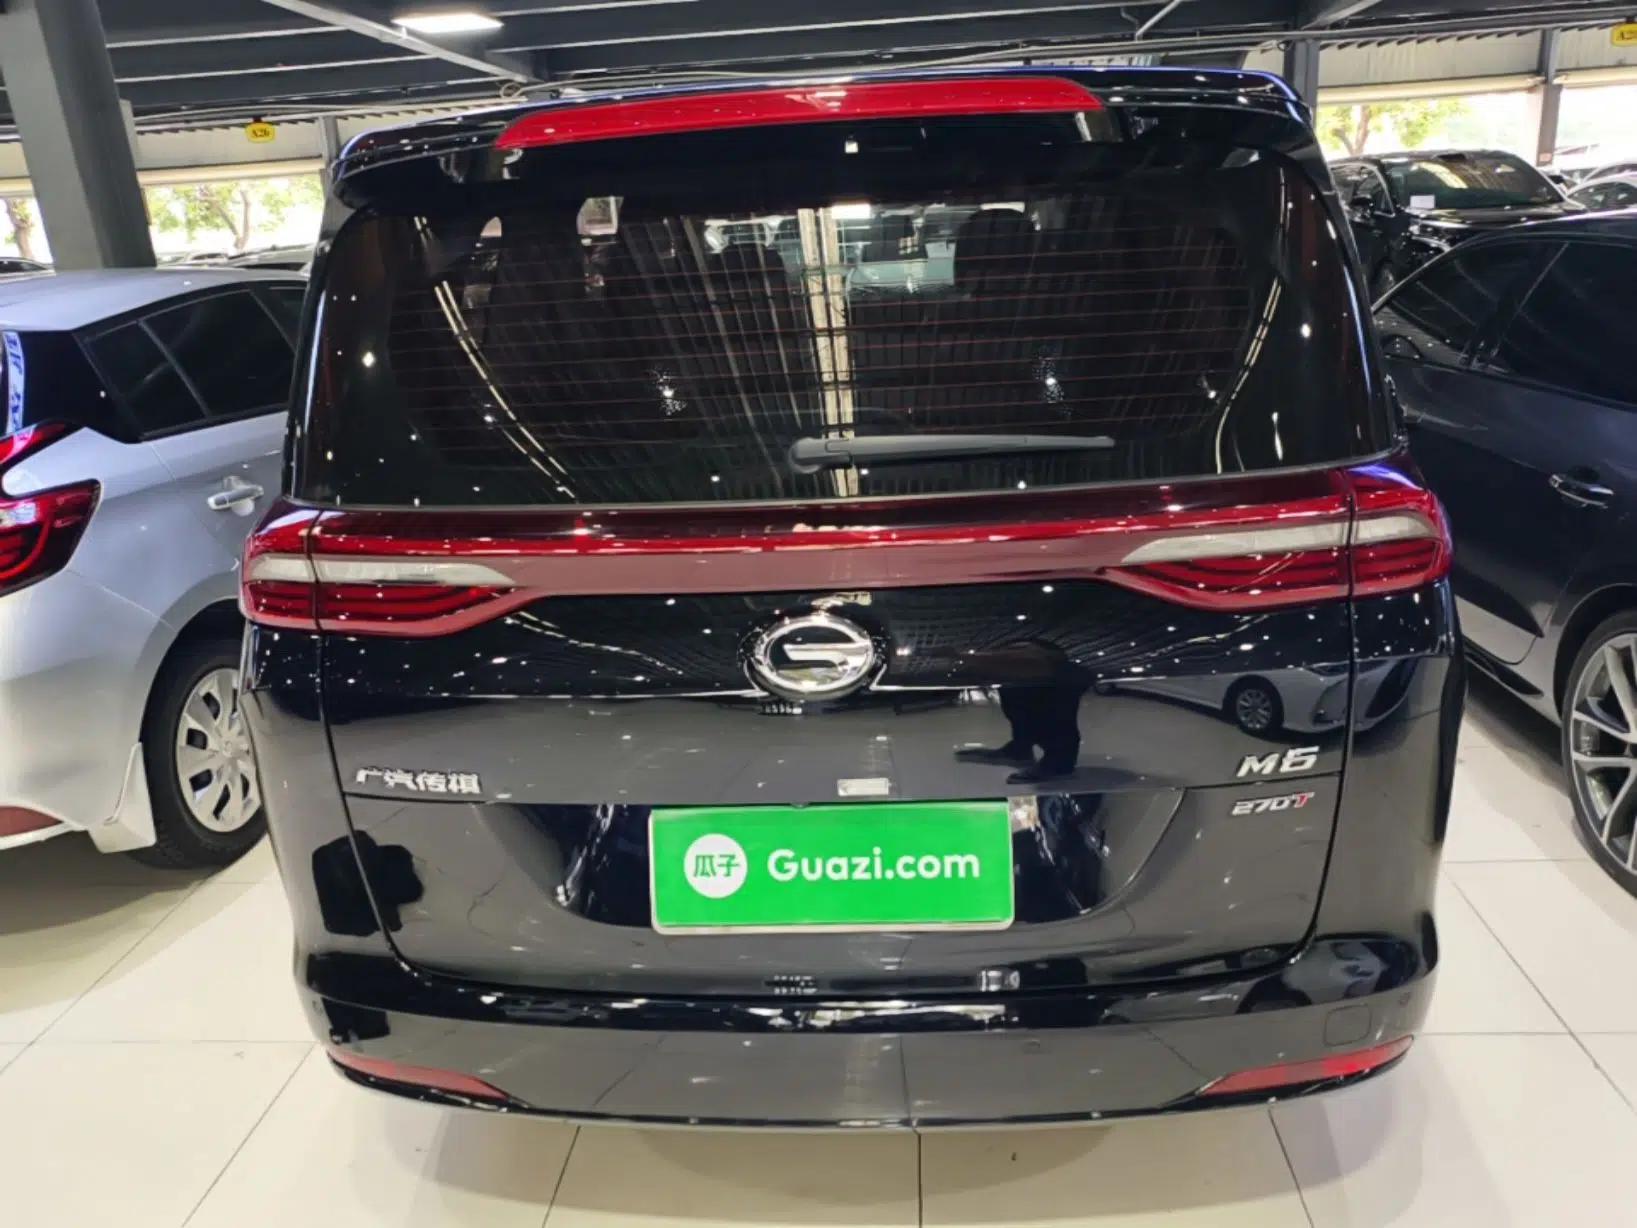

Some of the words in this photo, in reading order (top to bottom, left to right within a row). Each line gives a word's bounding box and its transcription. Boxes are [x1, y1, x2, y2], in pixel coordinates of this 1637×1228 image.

[1236, 746, 1320, 777] M6
[356, 768, 480, 794] 广汽传祺
[1231, 791, 1315, 816] 270T
[693, 854, 740, 878] 瓜子
[767, 846, 980, 881] Guazi.com
